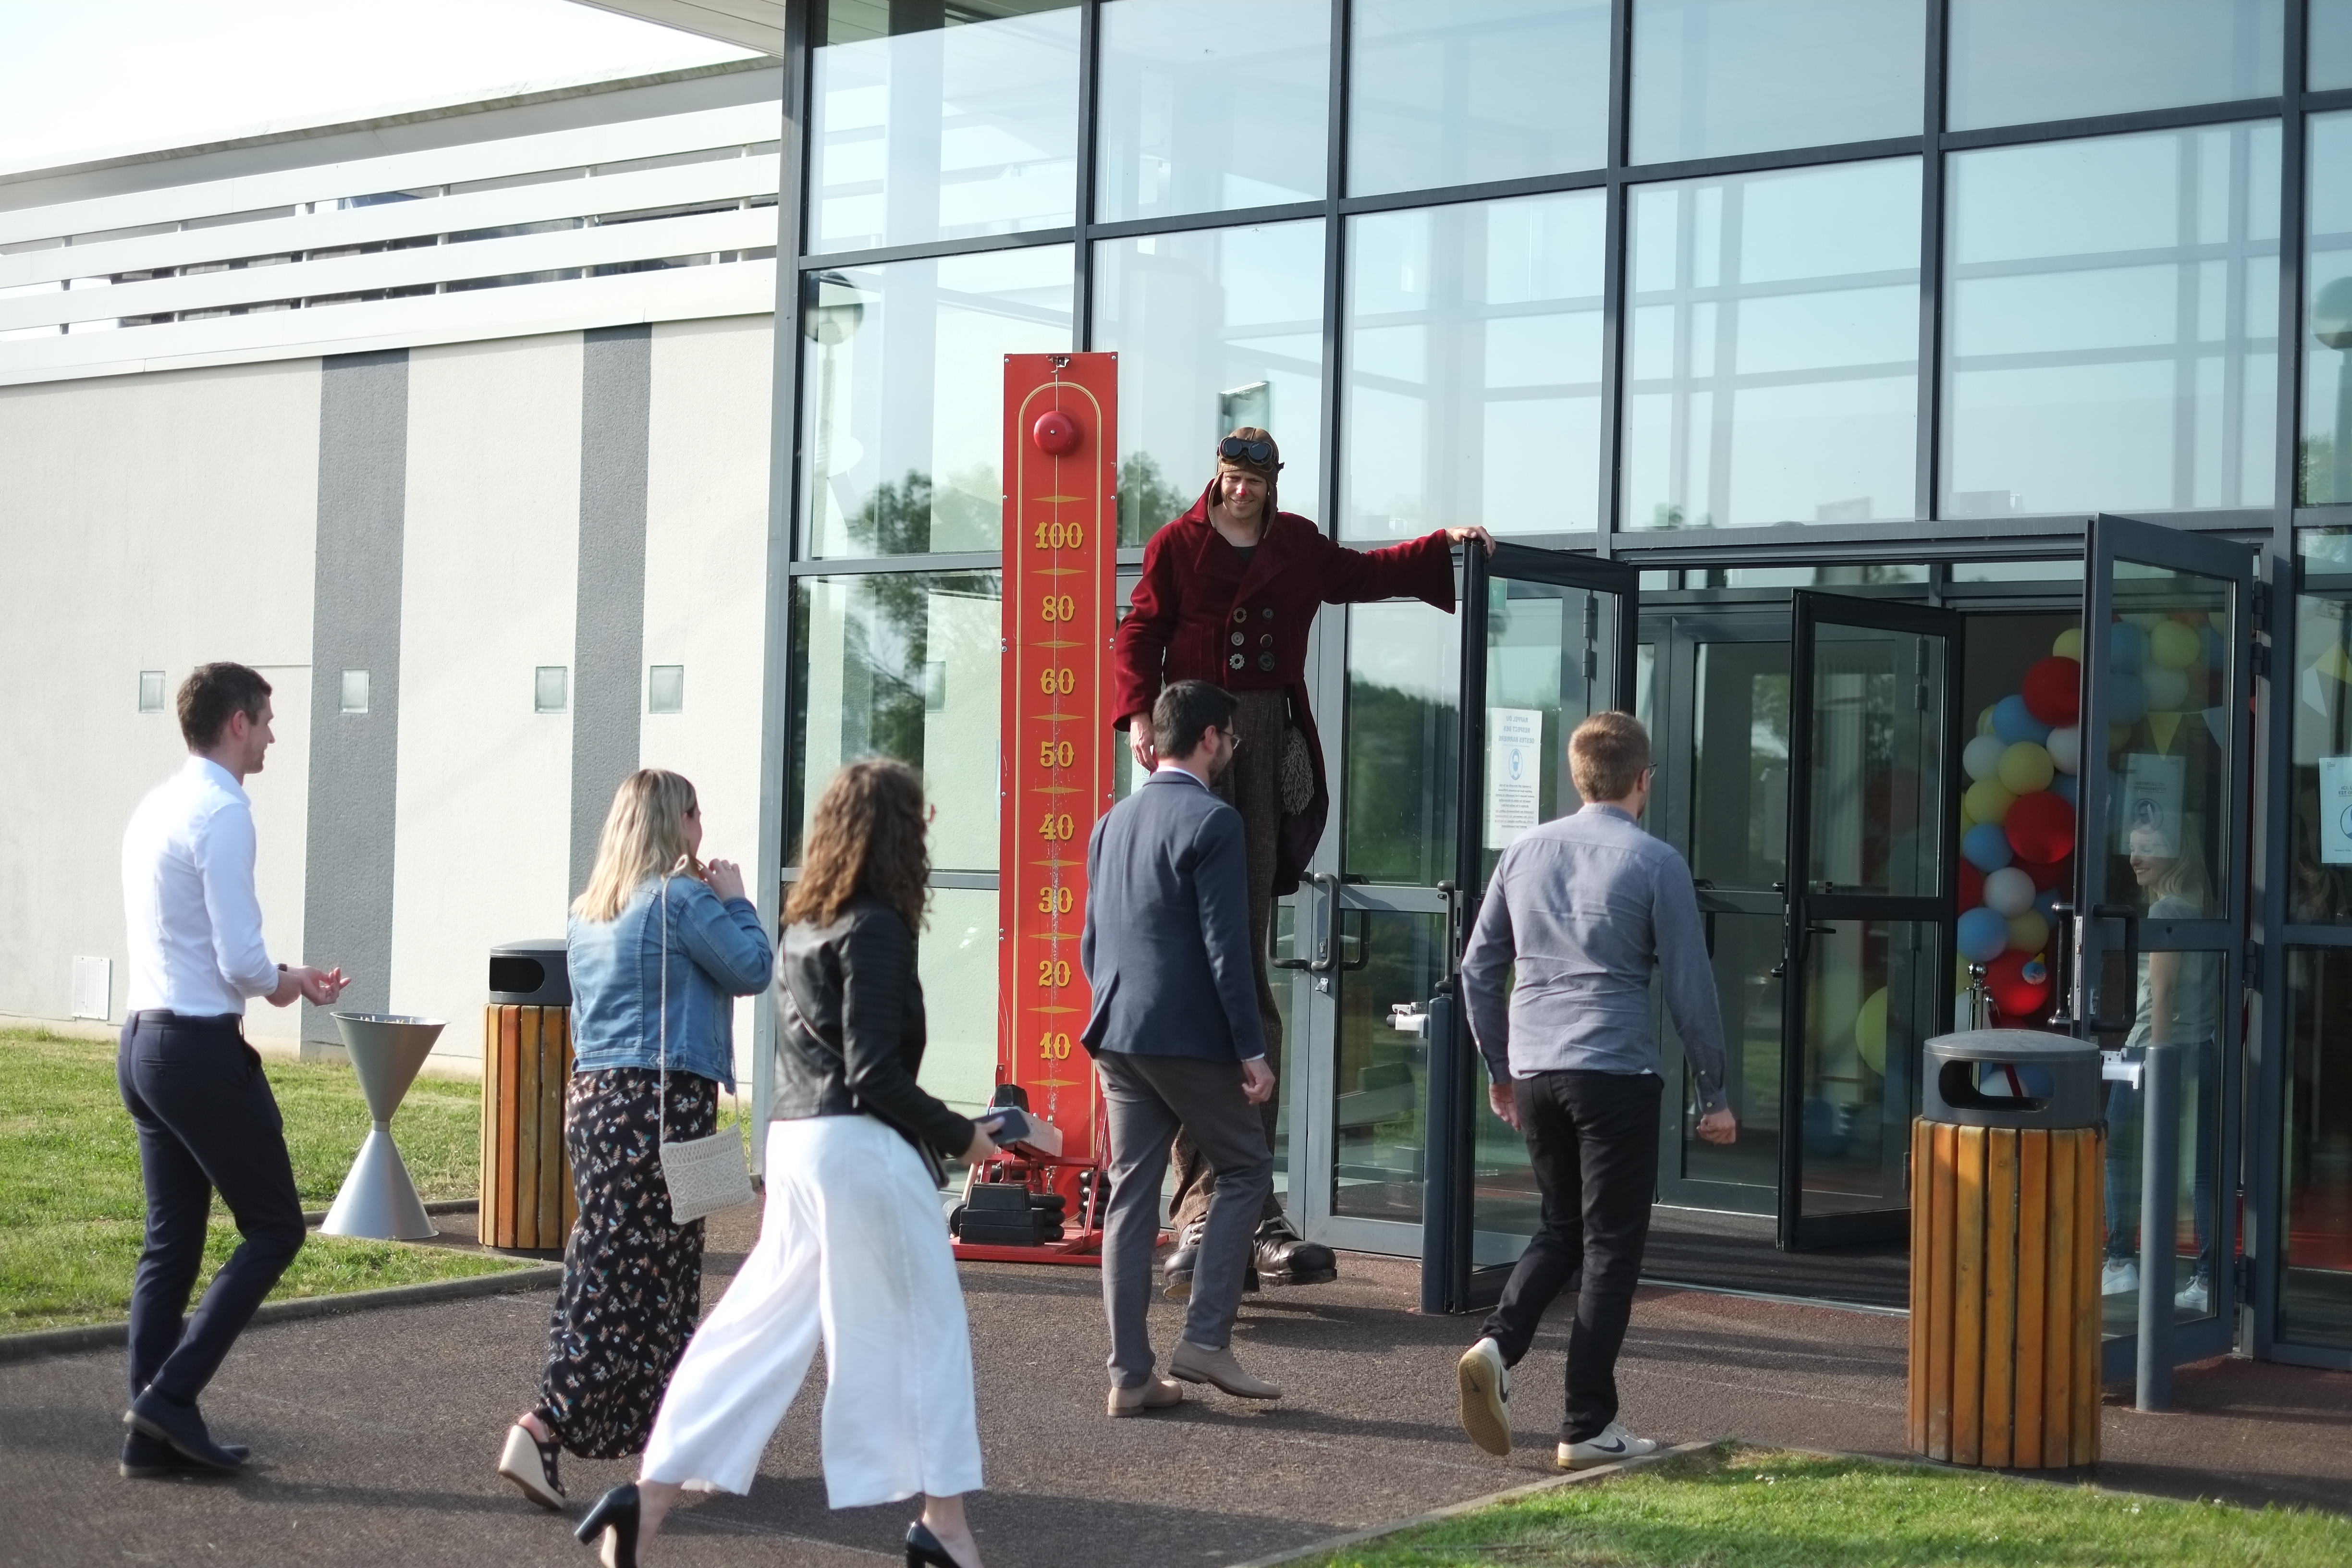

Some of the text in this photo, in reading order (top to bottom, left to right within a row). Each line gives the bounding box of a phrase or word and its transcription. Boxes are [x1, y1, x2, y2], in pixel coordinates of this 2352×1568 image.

[1034, 522, 1083, 549] 100
[1041, 595, 1075, 621] 80
[1040, 668, 1075, 695] 60
[1040, 741, 1074, 767] 50
[1039, 814, 1074, 840] 40
[1038, 887, 1073, 913] 30
[1039, 960, 1071, 987] 20
[1040, 1031, 1071, 1059] 10
